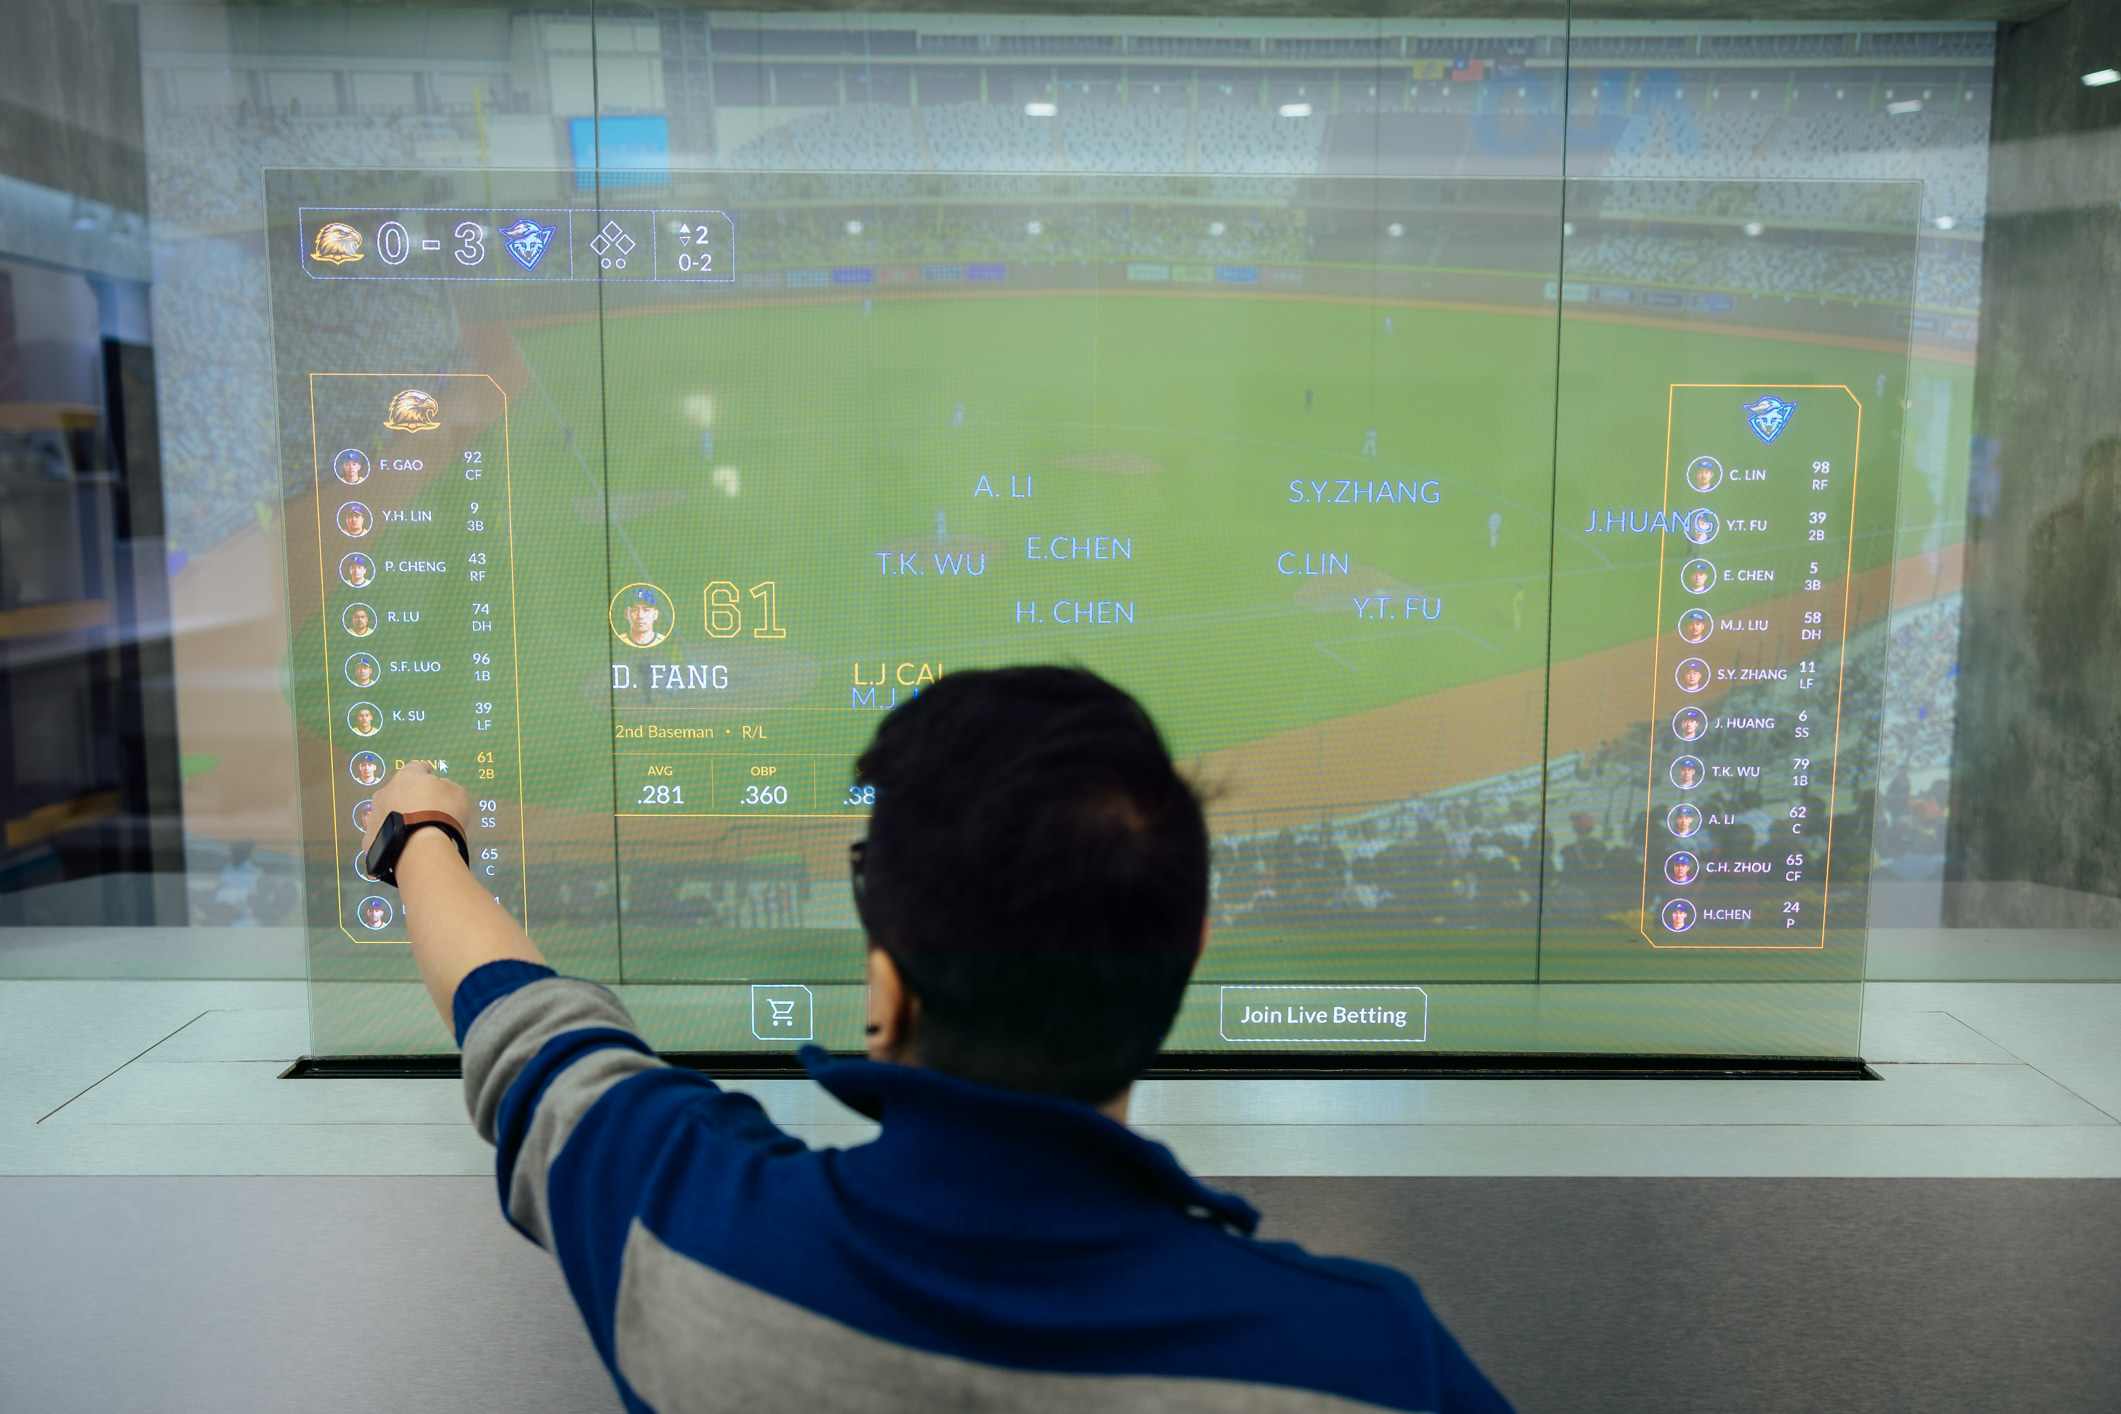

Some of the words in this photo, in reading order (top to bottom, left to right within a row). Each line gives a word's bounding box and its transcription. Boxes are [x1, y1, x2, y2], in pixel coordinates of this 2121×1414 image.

[695, 226, 709, 244] 2
[377, 221, 409, 265] 0
[454, 222, 485, 265] 3
[678, 254, 712, 272] 0-2
[464, 451, 482, 464] 92
[380, 460, 389, 471] F.
[393, 459, 423, 471] GAO
[1812, 461, 1830, 474] 98
[465, 469, 482, 480] CF
[1729, 469, 1742, 481] C.
[1745, 469, 1766, 481] LIN
[974, 475, 1000, 498] A.
[1011, 475, 1032, 498] LI
[1812, 480, 1828, 490] RF
[1289, 479, 1441, 504] S.Y.ZHANG
[470, 502, 479, 514] 9
[382, 510, 407, 522] Y.H.
[411, 510, 432, 522] LIN
[1585, 509, 1715, 533] J.HUANG
[1809, 512, 1827, 524] 39
[467, 520, 484, 531] 3B
[1726, 520, 1747, 531] Y.T.
[1750, 520, 1767, 531] FU
[1808, 530, 1825, 541] 2B
[1027, 536, 1132, 560] E.CHEN
[468, 553, 486, 565] 43
[875, 552, 924, 575] T.K.
[934, 552, 985, 576] WU
[1277, 552, 1349, 575] C.LIN
[385, 561, 395, 572] P.
[399, 561, 446, 572] CHENG
[1810, 562, 1818, 574] 5
[470, 571, 486, 581] RF
[1723, 570, 1734, 581] E.
[1737, 570, 1774, 581] CHEN
[1805, 580, 1821, 591] 3B
[472, 603, 489, 615] 74
[704, 581, 786, 638] 61
[1016, 601, 1043, 623] H.
[1053, 601, 1134, 624] CHEN
[1353, 596, 1394, 619] Y.T.
[1405, 596, 1441, 620] FU
[387, 611, 399, 622] R.
[403, 611, 419, 622] LU
[1804, 612, 1821, 624] 58
[472, 621, 492, 631] DH
[1721, 620, 1744, 631] M.J.
[1748, 620, 1769, 631] LIU
[1801, 629, 1821, 640] DH
[472, 653, 490, 665] 96
[390, 661, 410, 672] S.F.
[414, 661, 441, 672] LUO
[1800, 661, 1815, 672] 11
[475, 671, 490, 681] 1B
[612, 665, 638, 689] D.
[651, 665, 729, 689] FANG
[1717, 669, 1737, 680] S.Y.
[1740, 669, 1788, 680] ZHANG
[1800, 679, 1814, 689] LF
[475, 703, 492, 714] 39
[393, 711, 405, 721] K.
[408, 711, 425, 721] SU
[1799, 710, 1807, 722] 6
[477, 720, 491, 730] LF
[1714, 718, 1723, 728] J.
[1727, 718, 1775, 728] HUANG
[615, 725, 643, 738] 2nd
[648, 725, 713, 738] Baseman
[742, 726, 767, 740] R/L
[1795, 727, 1809, 738] SS
[477, 752, 494, 763] 61
[1793, 758, 1810, 770] 79
[478, 769, 494, 779] 2B
[647, 766, 673, 776] AVG
[750, 766, 777, 776] OBP
[1712, 766, 1733, 777] T.K.
[1737, 766, 1760, 777] WU
[1793, 776, 1808, 786] 1B
[637, 785, 684, 804] .281
[740, 785, 788, 804] .360
[843, 785, 878, 805] .38
[479, 800, 497, 812] 90
[1789, 806, 1806, 818] 62
[481, 818, 496, 828] SS
[1709, 814, 1720, 825] A.
[1725, 814, 1735, 825] LI
[1792, 824, 1801, 834] C
[481, 848, 498, 860] 65
[1786, 854, 1803, 866] 65
[486, 866, 495, 876] C
[1706, 862, 1730, 873] C.H.
[1734, 862, 1772, 873] ZHOU
[1785, 871, 1802, 882] CF
[1783, 902, 1800, 913] 24
[1703, 909, 1752, 920] H.CHEN
[1786, 919, 1795, 928] P
[1241, 1006, 1282, 1024] Join
[1287, 1006, 1328, 1024] Live
[1333, 1006, 1407, 1028] Betting
